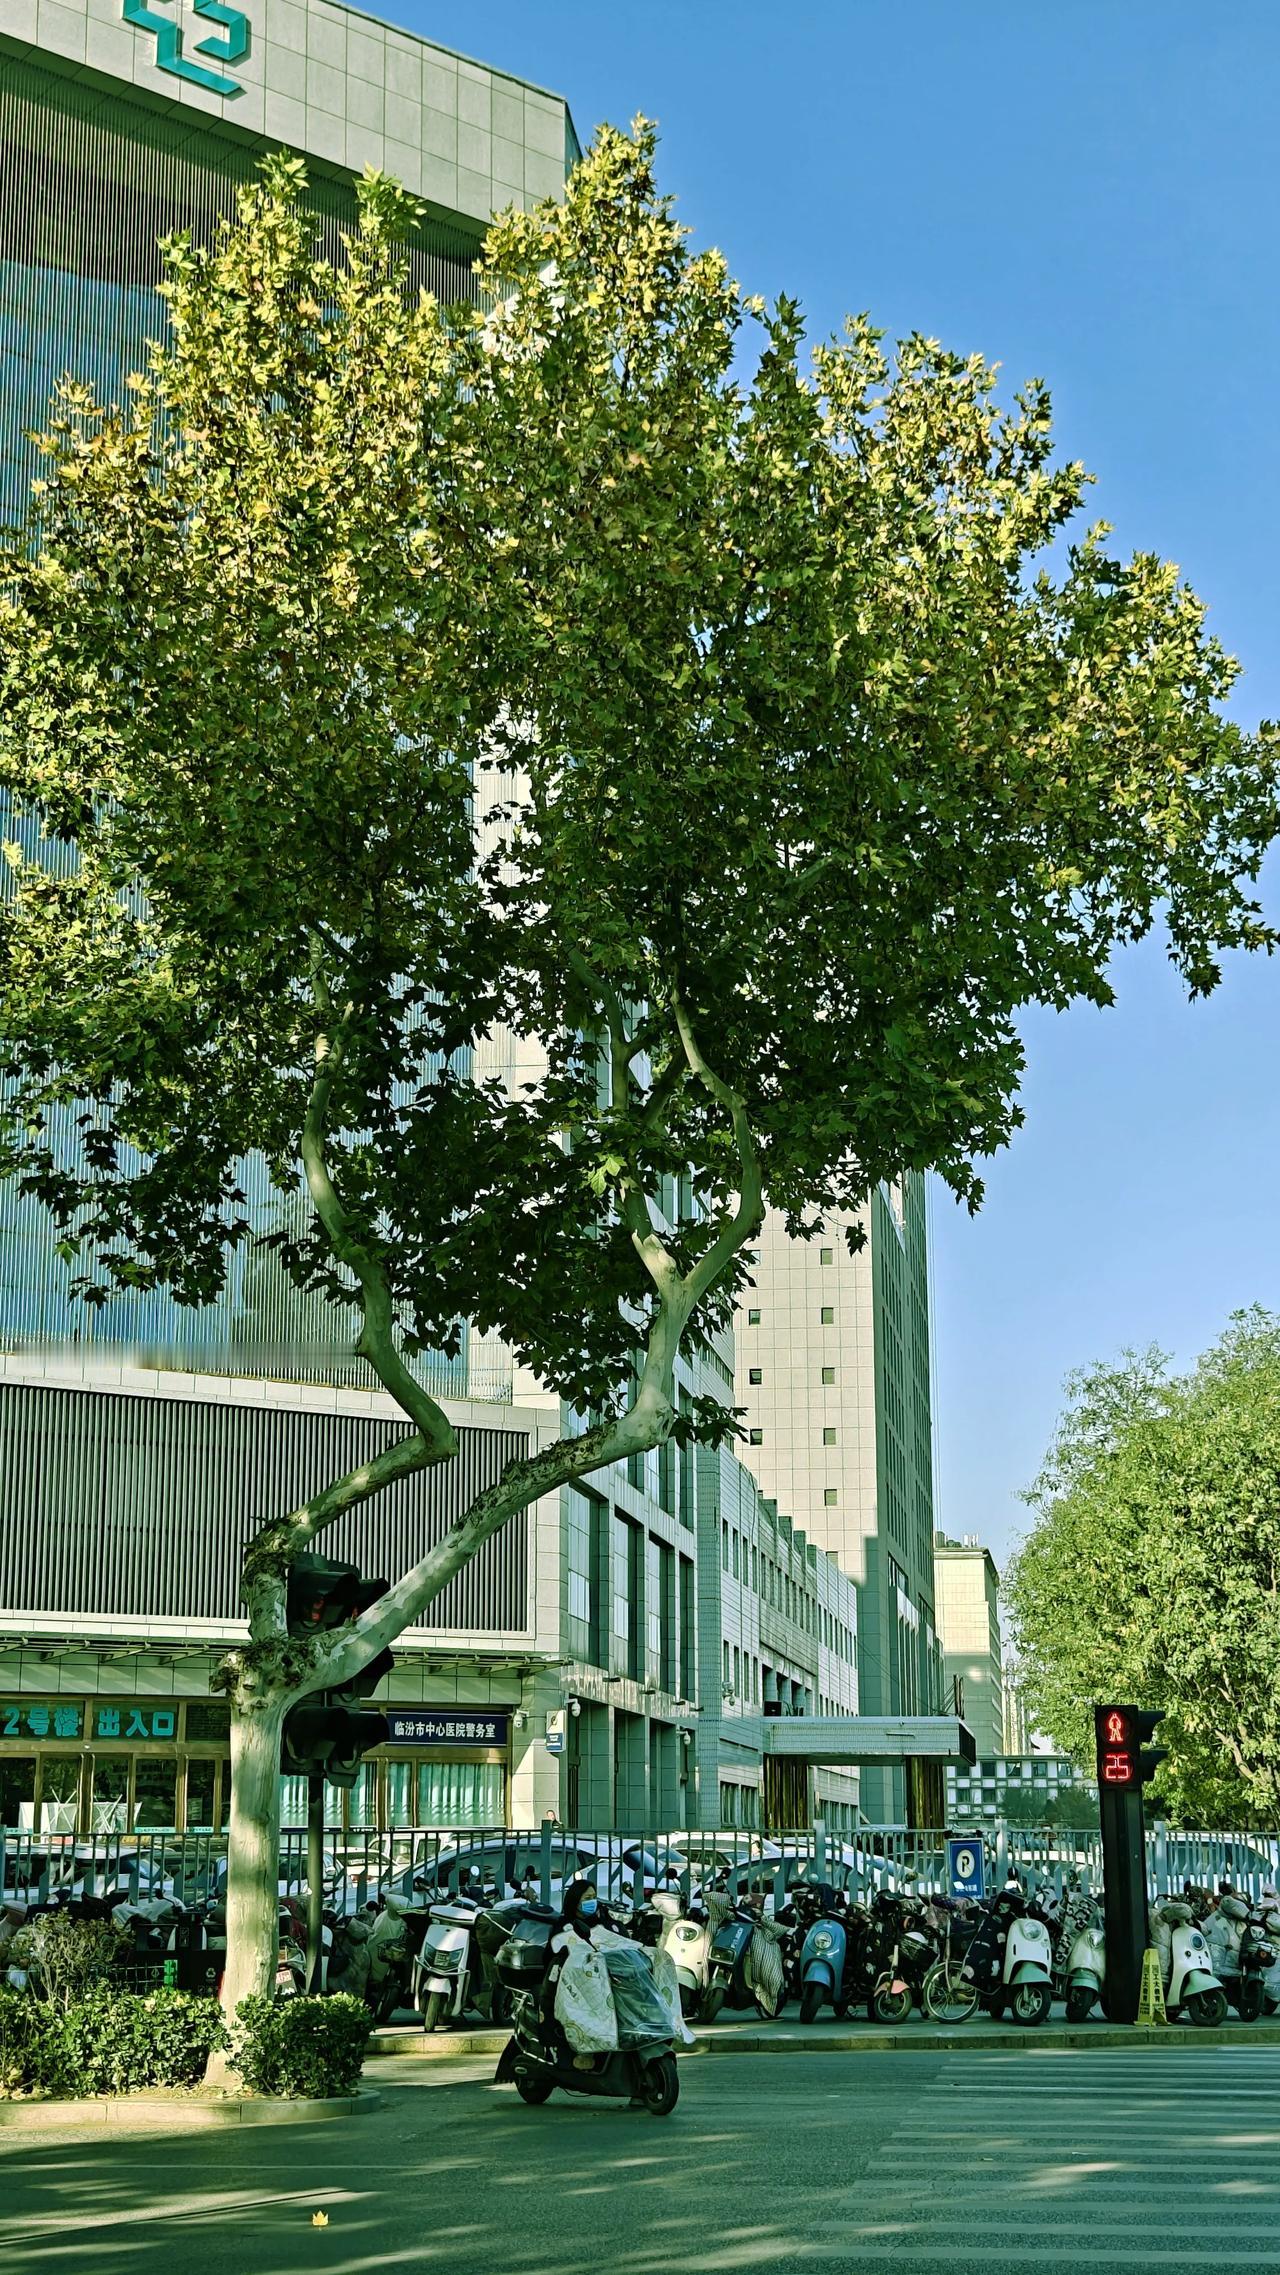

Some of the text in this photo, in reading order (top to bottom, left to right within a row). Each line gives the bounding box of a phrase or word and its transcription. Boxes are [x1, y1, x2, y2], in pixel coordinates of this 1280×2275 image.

[4, 1707, 174, 1737] 2号楼 出入口
[394, 1721, 496, 1738] 临汾市中心医院警务室
[1106, 1755, 1128, 1779] 25
